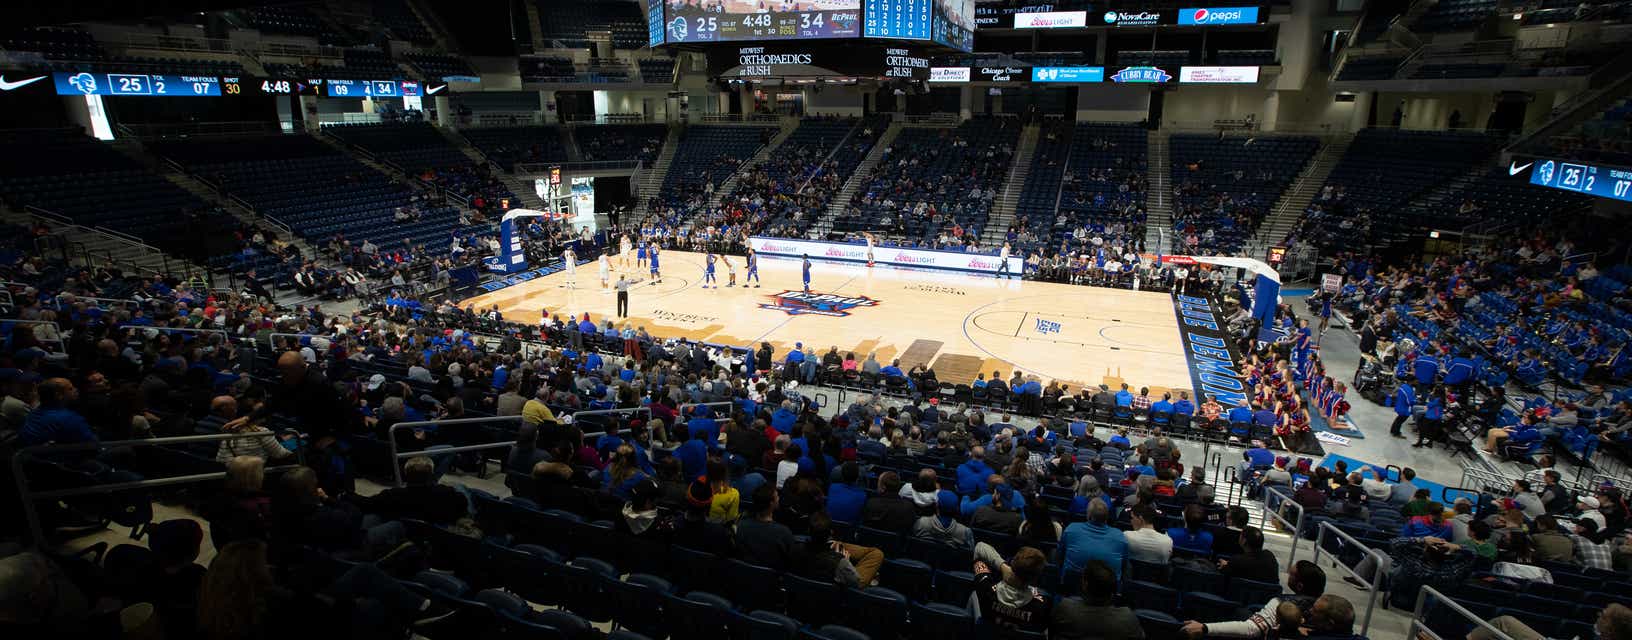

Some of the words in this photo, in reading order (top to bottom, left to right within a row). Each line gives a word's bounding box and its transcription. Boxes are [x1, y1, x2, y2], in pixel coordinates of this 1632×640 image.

[742, 14, 772, 27] 4:48
[800, 13, 824, 28] 34
[1117, 12, 1160, 21] NovaCare
[1210, 11, 1241, 22] pepsi
[696, 17, 717, 32] 25
[740, 54, 812, 65] ORTHOPAEDICS
[886, 56, 929, 67] ORTHOPAEDICS
[747, 66, 771, 75] RUSH
[893, 67, 912, 77] RUSH
[1120, 71, 1142, 80] CUBBY
[1143, 71, 1161, 80] BEAR
[119, 78, 141, 92] 25
[156, 82, 166, 93] 2
[193, 83, 210, 94] 07
[225, 83, 240, 94] 30
[261, 81, 291, 93] 4:48
[314, 85, 319, 94] 1
[335, 85, 348, 95] 09
[364, 86, 371, 95] 4
[378, 83, 391, 94] 34
[1563, 168, 1580, 186] 25
[1610, 170, 1624, 179] TEAM
[1585, 176, 1595, 191] 2
[1614, 180, 1631, 197] 07
[1177, 294, 1219, 331] BLUE
[1188, 332, 1252, 420] DEMON
